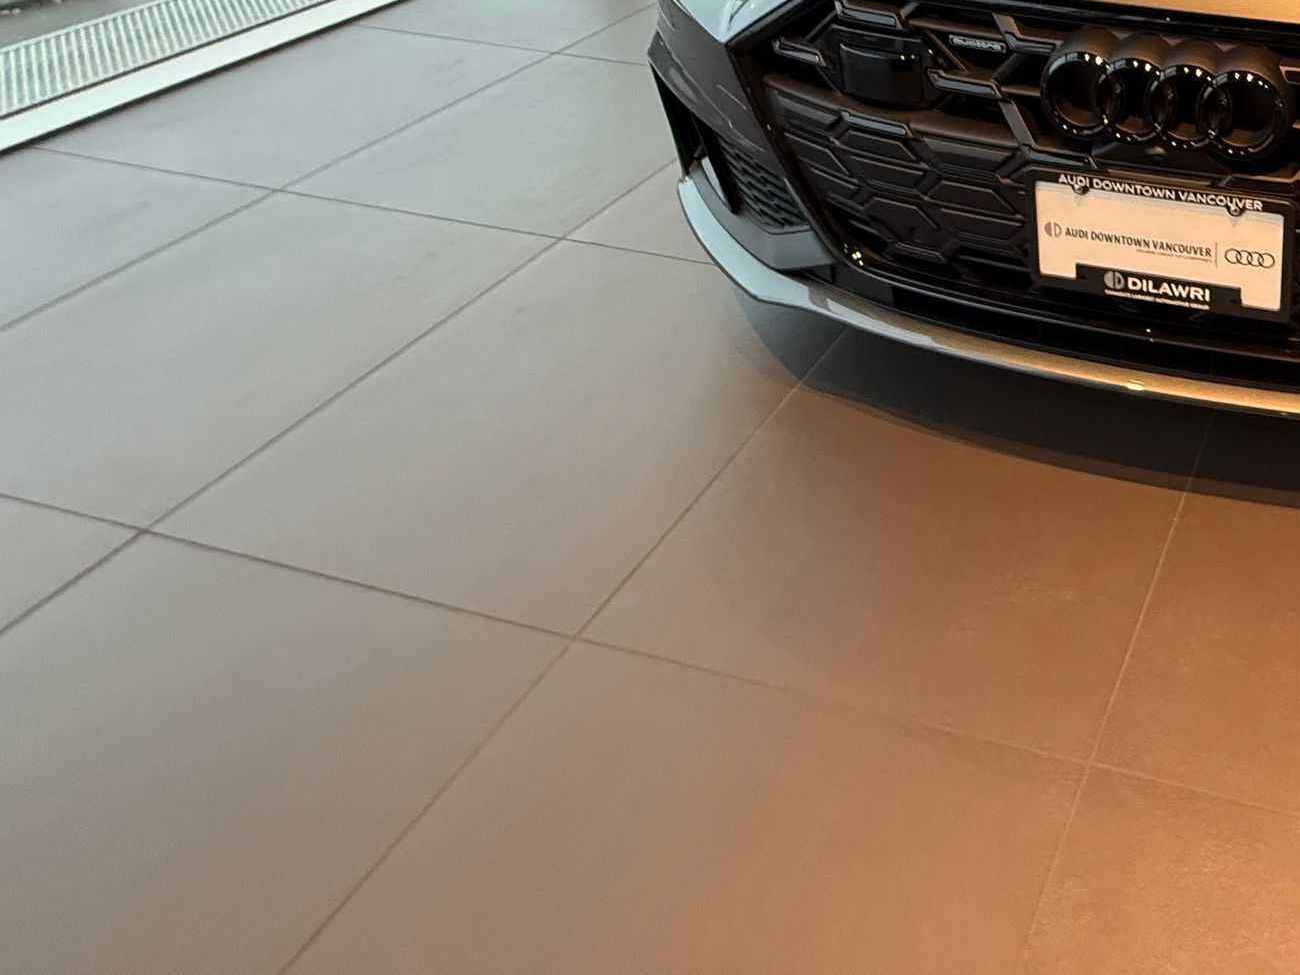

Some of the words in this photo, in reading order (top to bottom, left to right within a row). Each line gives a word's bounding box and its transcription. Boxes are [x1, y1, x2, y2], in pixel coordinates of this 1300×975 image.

[1058, 173, 1090, 188] AUDI
[1093, 179, 1176, 200] DOWNTOWN
[1177, 191, 1263, 212] VANCOUVER
[1064, 226, 1089, 240] AUDI
[1090, 230, 1150, 249] DOWNTOWN
[1151, 239, 1212, 258] VANCOUVER
[1127, 277, 1211, 302] DILAWRI
